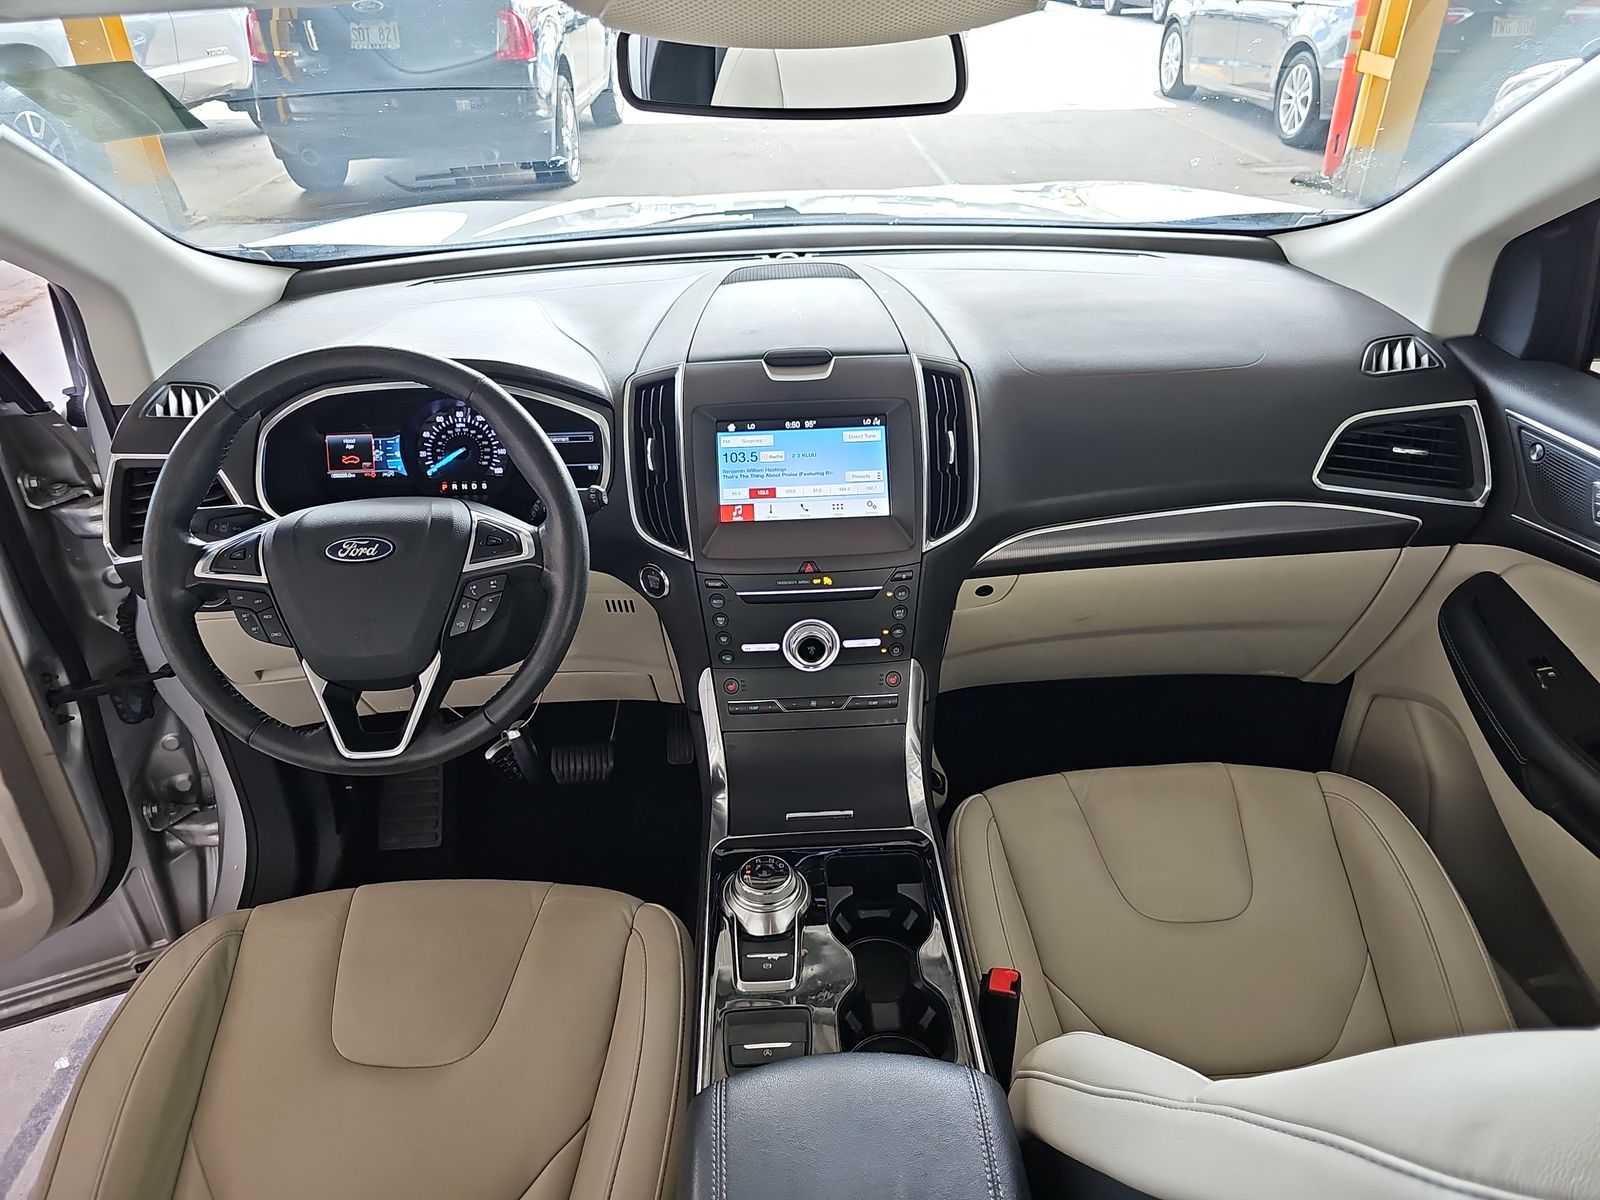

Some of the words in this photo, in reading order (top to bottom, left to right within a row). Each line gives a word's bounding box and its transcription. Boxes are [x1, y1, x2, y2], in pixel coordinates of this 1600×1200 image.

[785, 421, 800, 429] 6:50
[723, 451, 758, 463] 103.5
[338, 540, 379, 557] Ford
